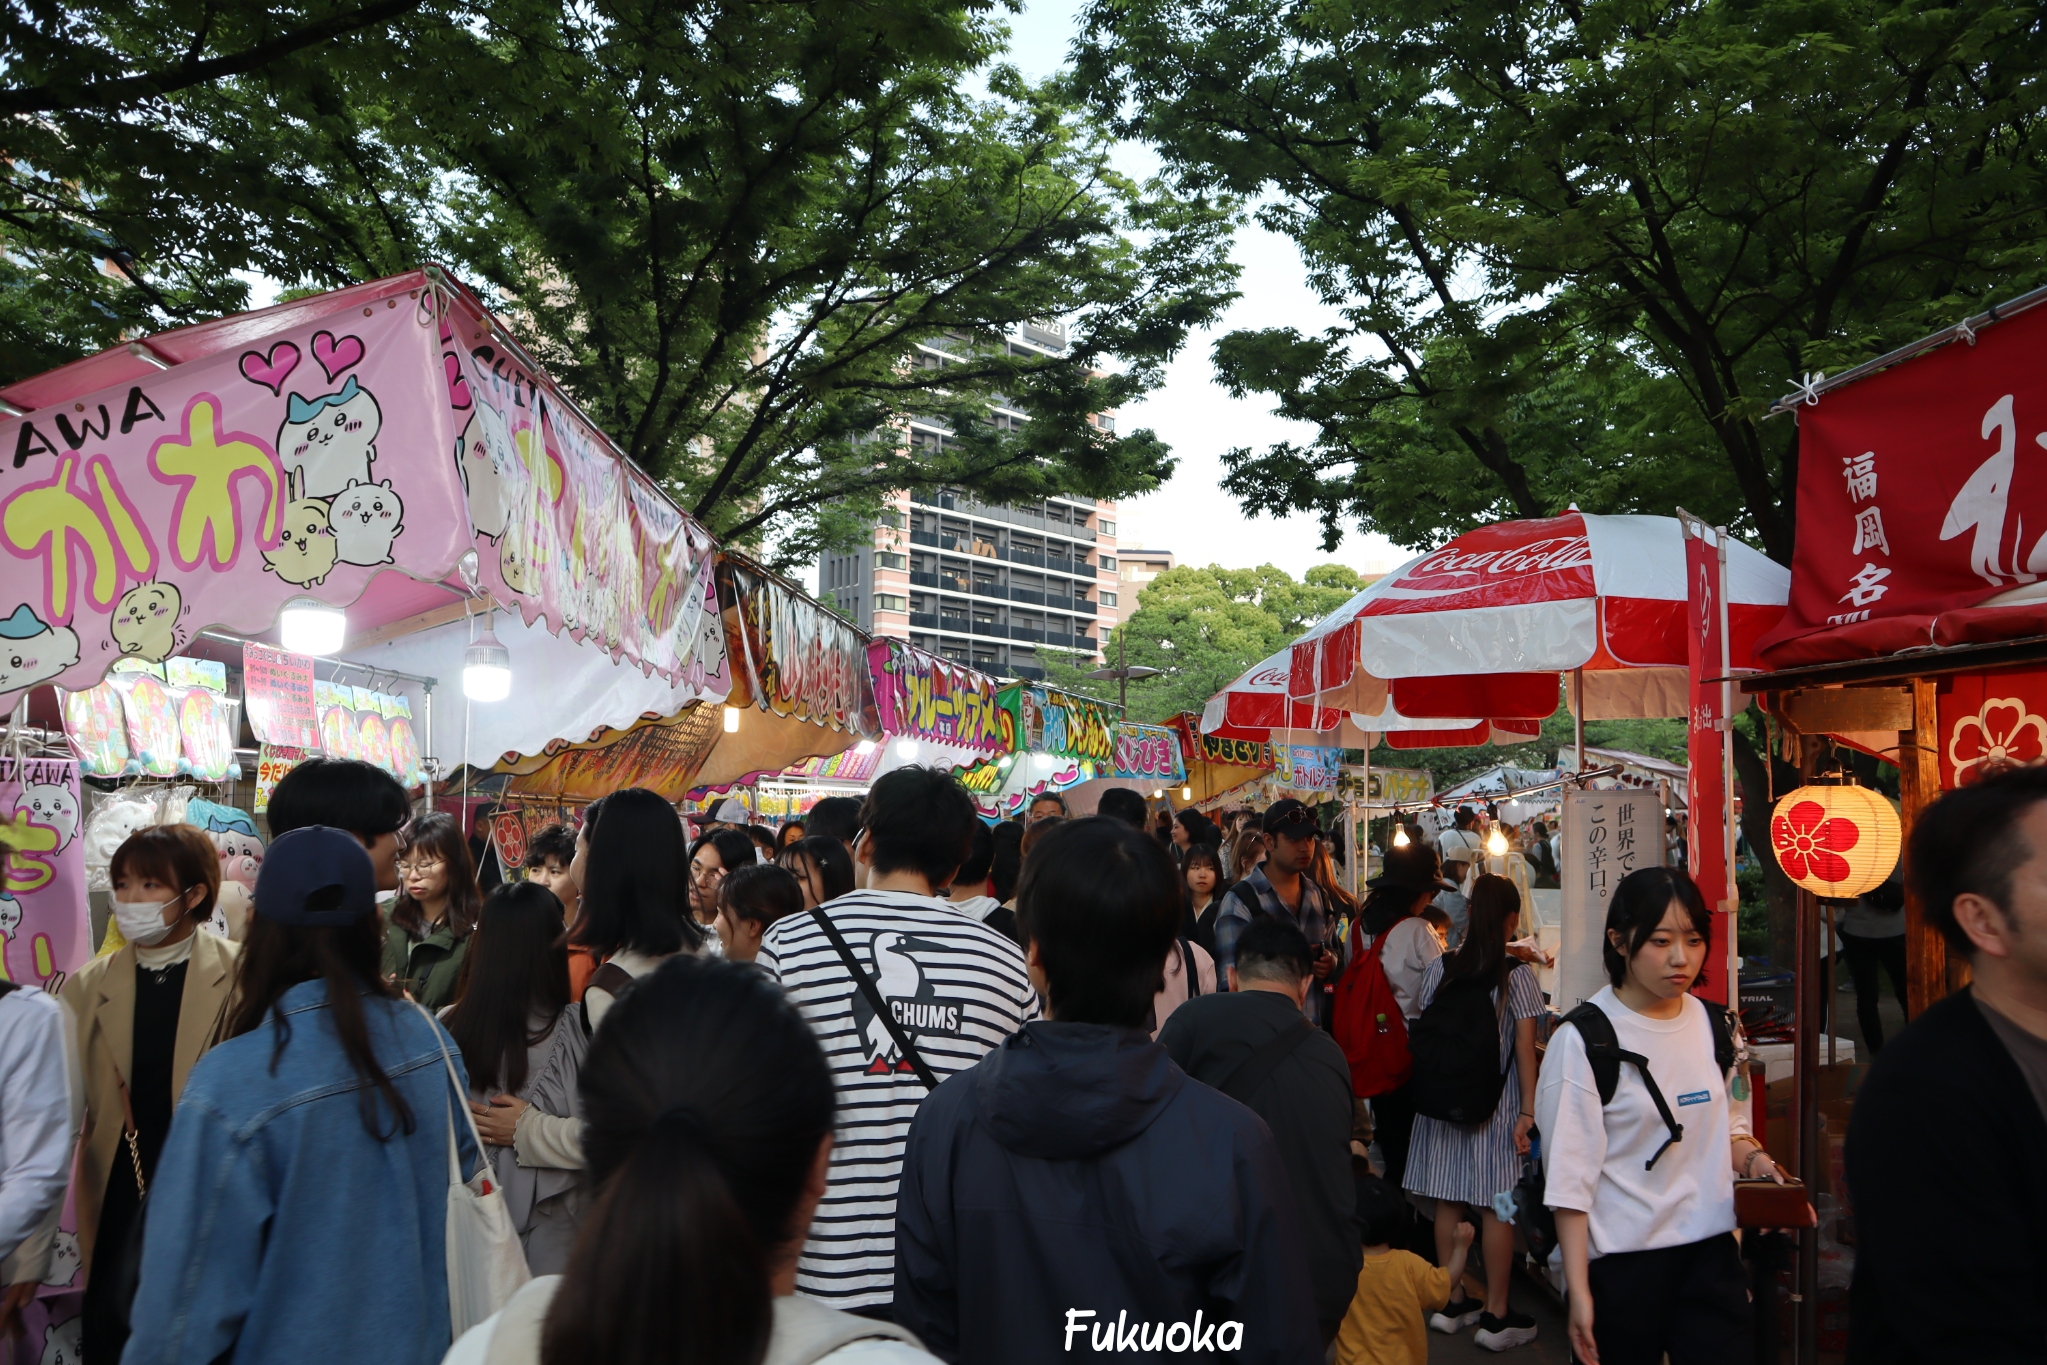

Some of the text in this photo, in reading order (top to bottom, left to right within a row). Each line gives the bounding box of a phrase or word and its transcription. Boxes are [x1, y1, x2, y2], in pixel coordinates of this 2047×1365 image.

[0, 387, 165, 473] AWA
[0, 391, 285, 627] かわ
[1827, 451, 1893, 624] 福岡名
[904, 672, 997, 745] フルーツアメ
[1115, 734, 1171, 775] くじびき
[1202, 733, 1260, 765] やきとり
[1588, 803, 1608, 898] この辛口。
[891, 1000, 959, 1031] CHUMS
[1740, 995, 1774, 1003] TRIAL
